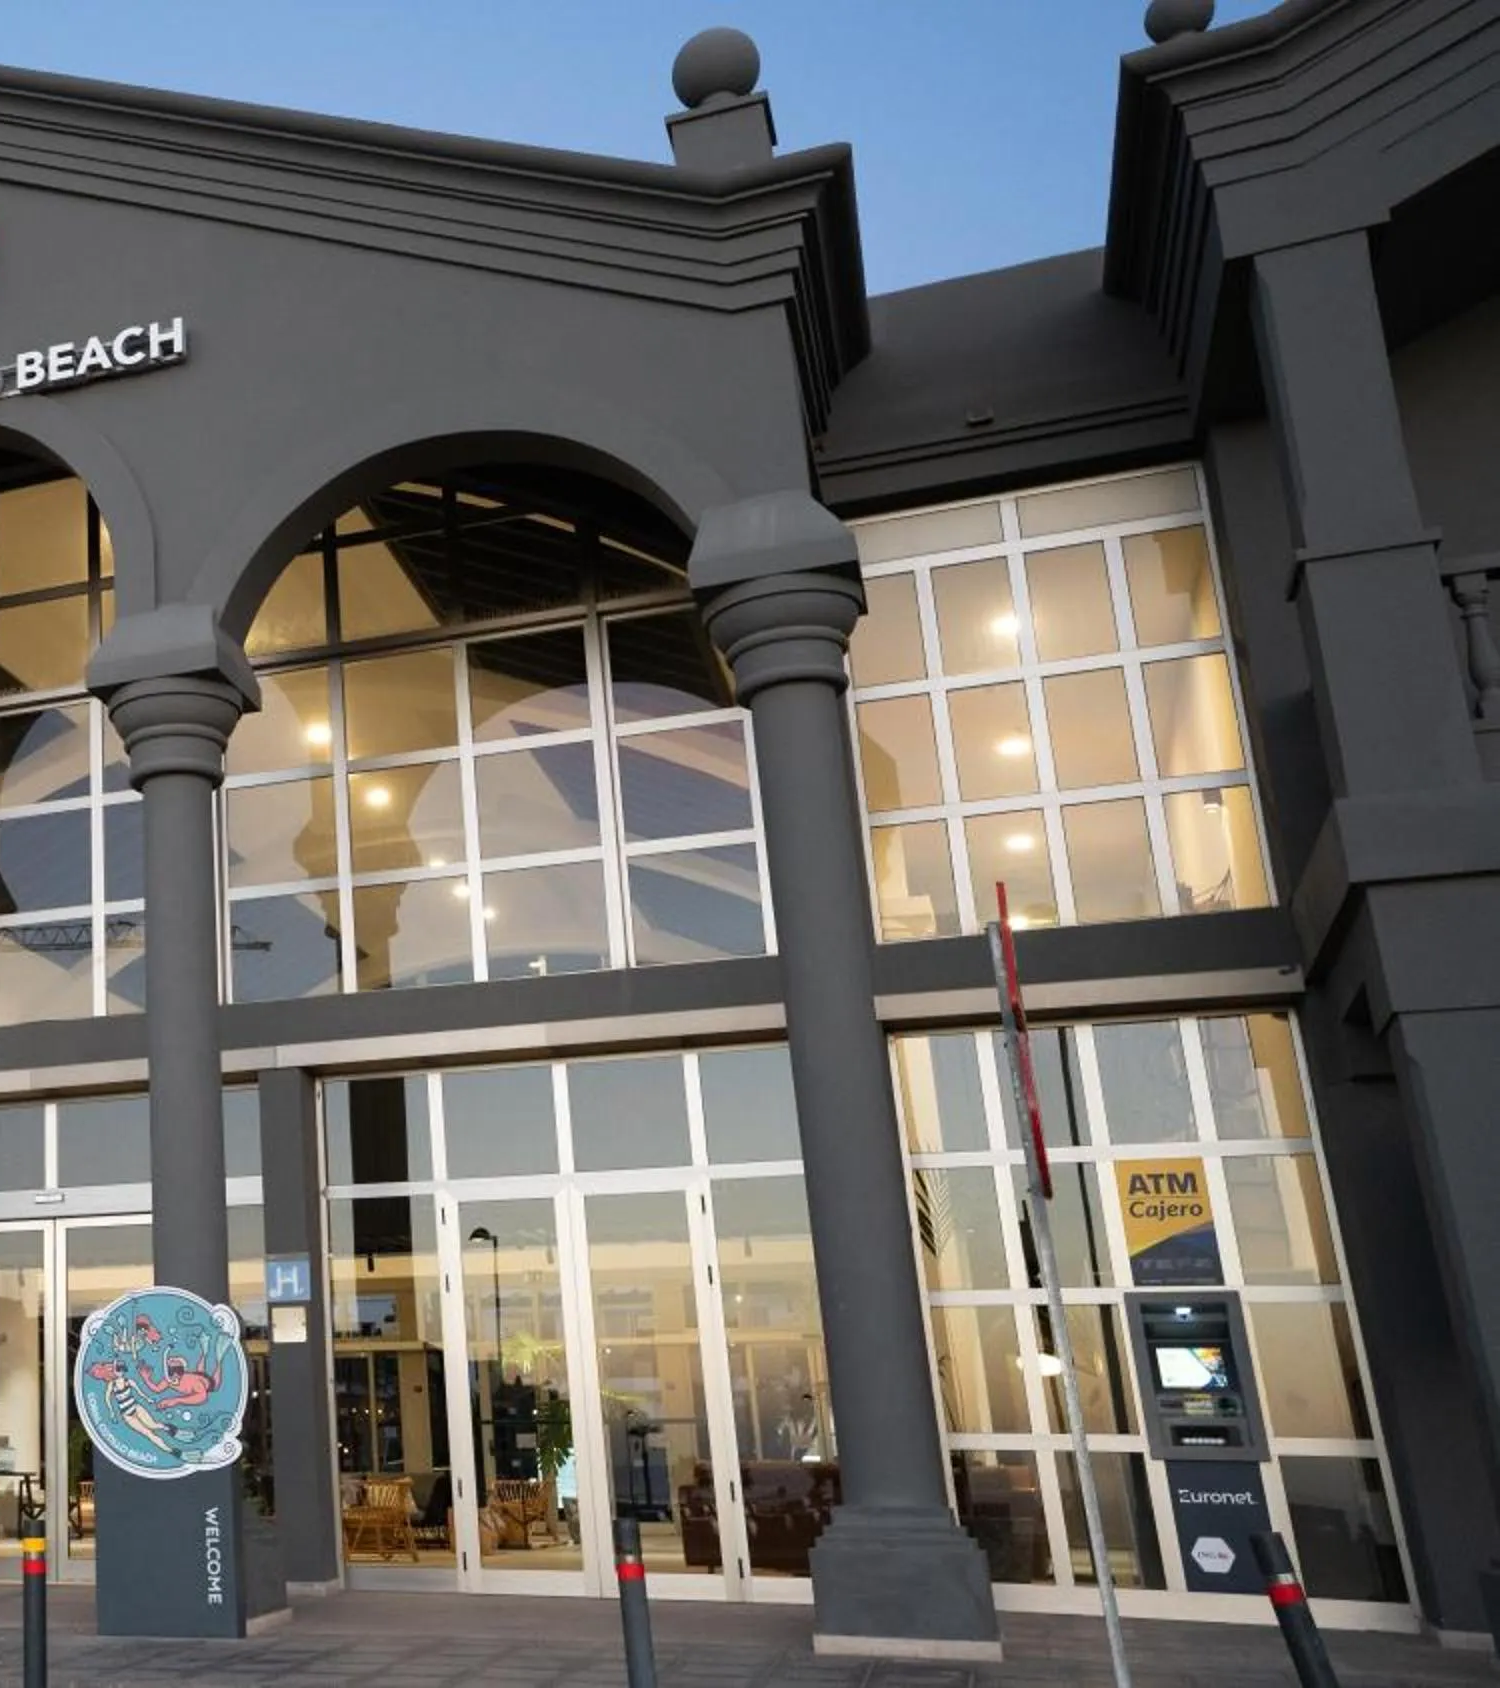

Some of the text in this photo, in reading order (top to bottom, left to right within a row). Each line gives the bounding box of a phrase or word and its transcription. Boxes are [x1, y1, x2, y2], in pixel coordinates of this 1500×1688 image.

[17, 317, 183, 389] BEACH
[1128, 1172, 1198, 1195] ATM
[1129, 1201, 1203, 1221] Cajero
[276, 1265, 298, 1297] H
[1178, 1488, 1258, 1505] Euronet
[205, 1507, 222, 1604] WELCOME
